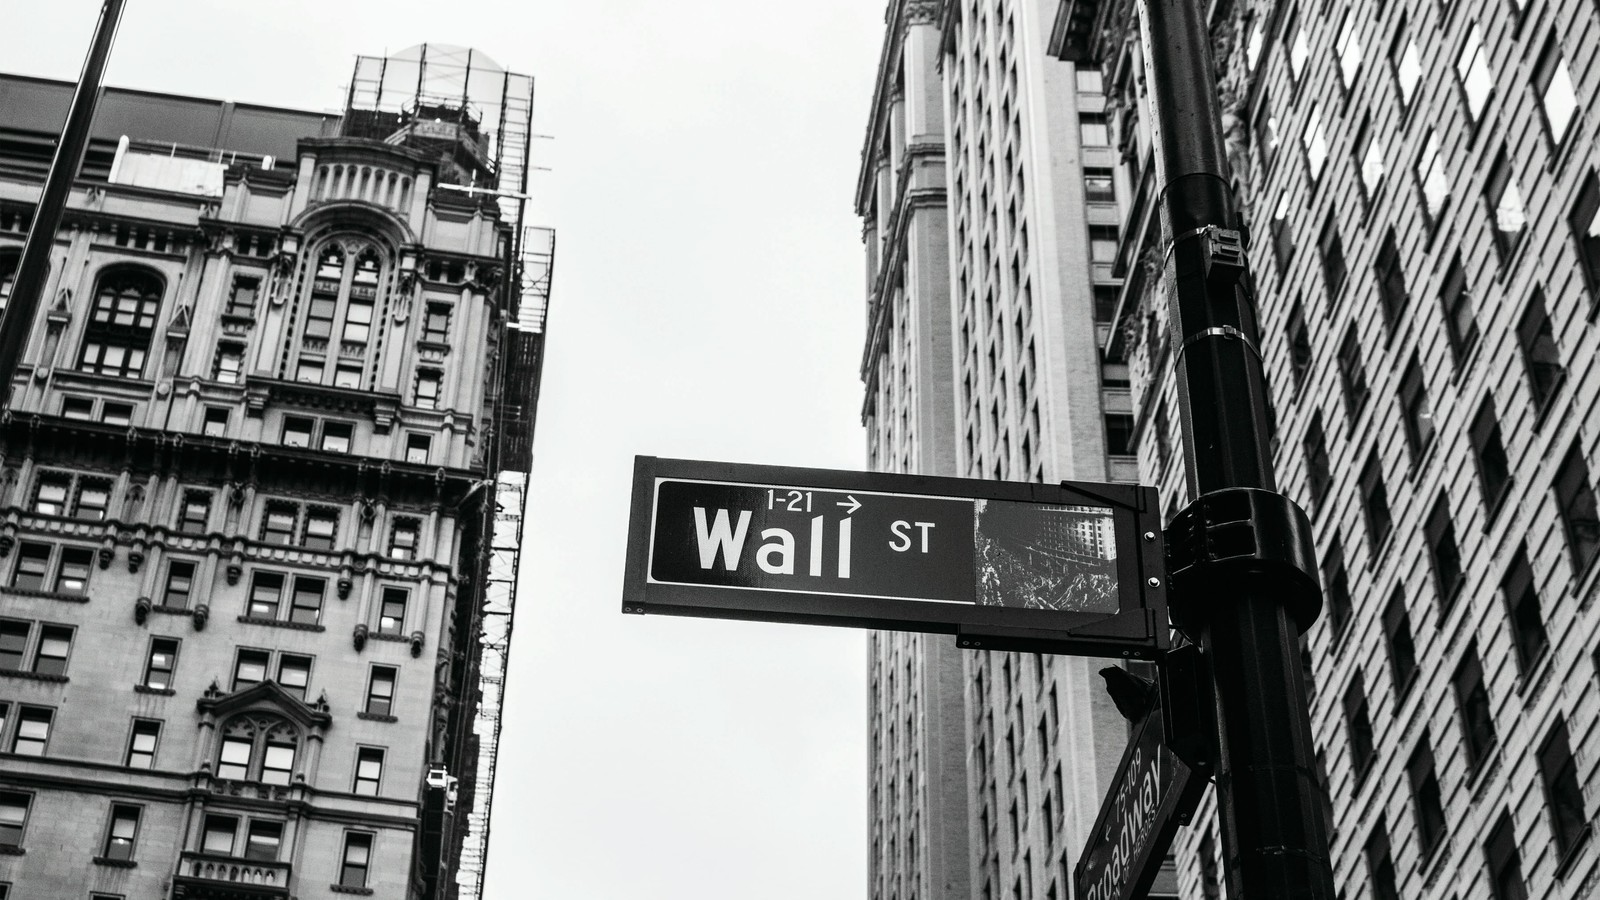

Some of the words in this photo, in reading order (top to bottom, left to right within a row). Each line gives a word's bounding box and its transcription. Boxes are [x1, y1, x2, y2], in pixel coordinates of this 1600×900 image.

[767, 489, 812, 513] 1-21
[693, 506, 852, 579] Wall
[888, 519, 936, 554] ST
[1087, 743, 1162, 900] roadway
[1114, 747, 1142, 823] 75-109
